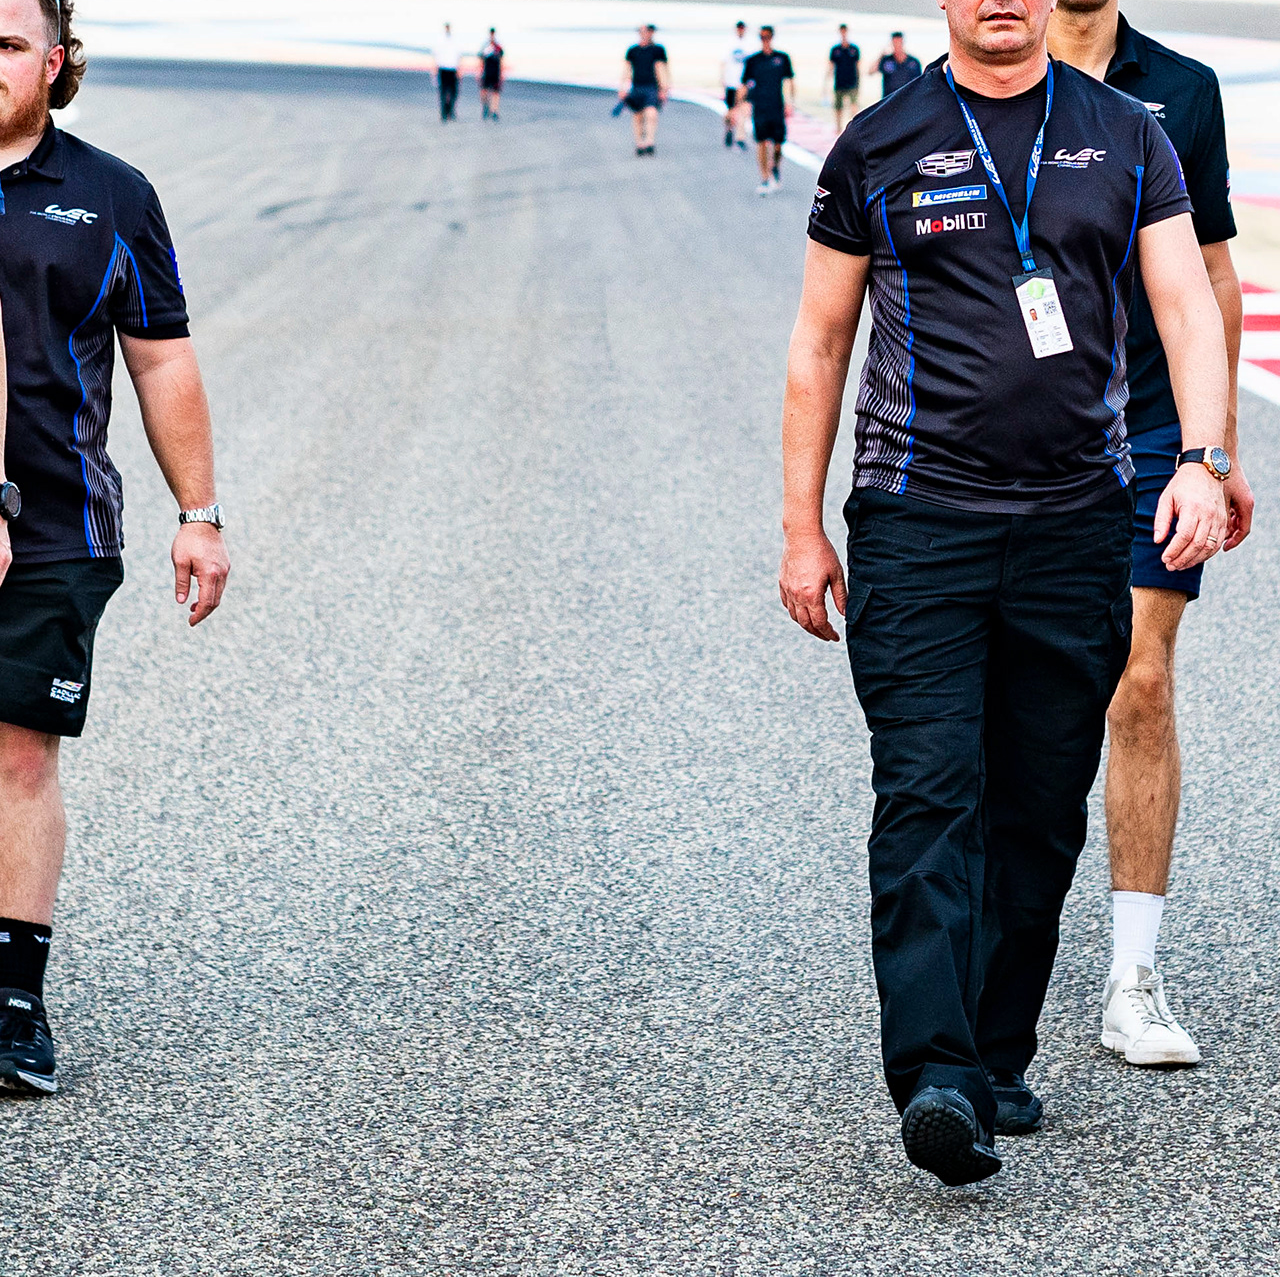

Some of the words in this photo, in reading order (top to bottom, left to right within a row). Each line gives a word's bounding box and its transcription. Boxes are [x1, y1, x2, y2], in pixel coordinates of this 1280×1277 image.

[1054, 148, 1107, 162] WEC
[933, 190, 980, 201] MICHELIN
[44, 204, 99, 224] WEC
[915, 213, 966, 235] Mobil
